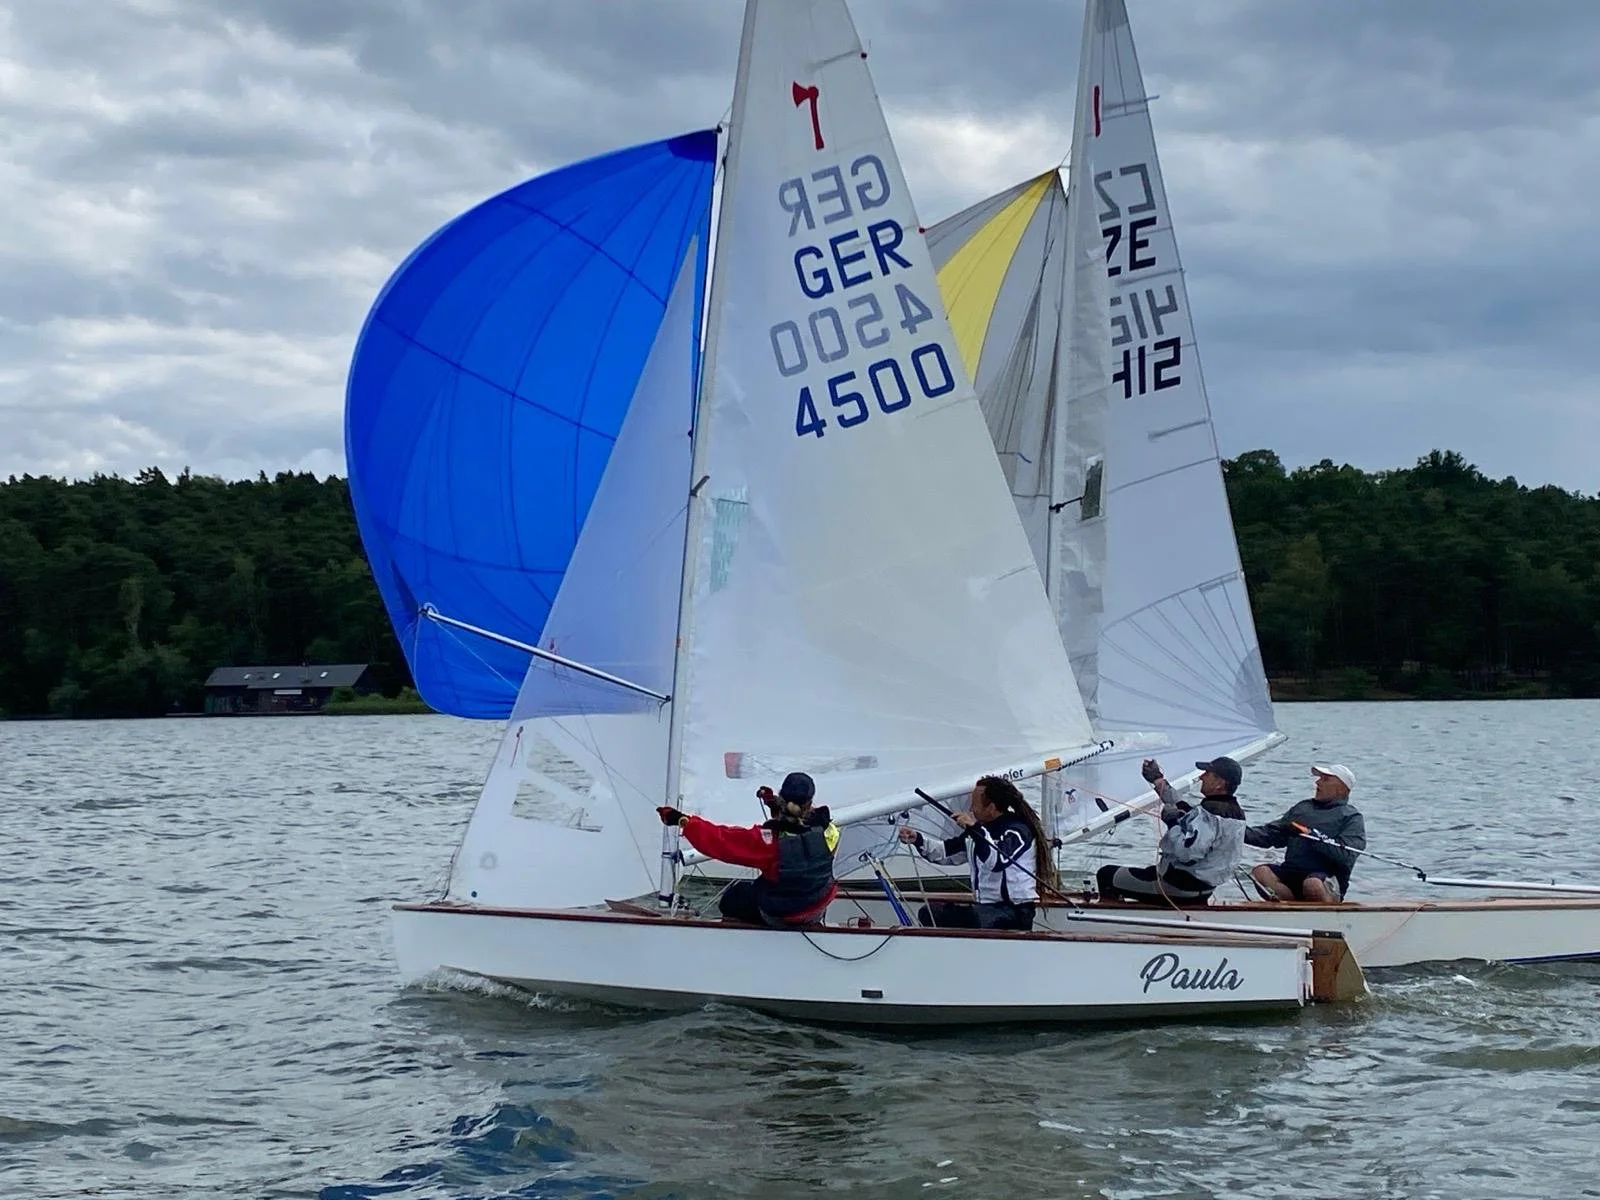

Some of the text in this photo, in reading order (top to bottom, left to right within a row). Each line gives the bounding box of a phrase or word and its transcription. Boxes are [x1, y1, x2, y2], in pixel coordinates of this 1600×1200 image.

[793, 219, 913, 299] GER
[1102, 216, 1157, 277] ZE
[795, 343, 956, 438] 4500
[1140, 953, 1244, 993] Paula
